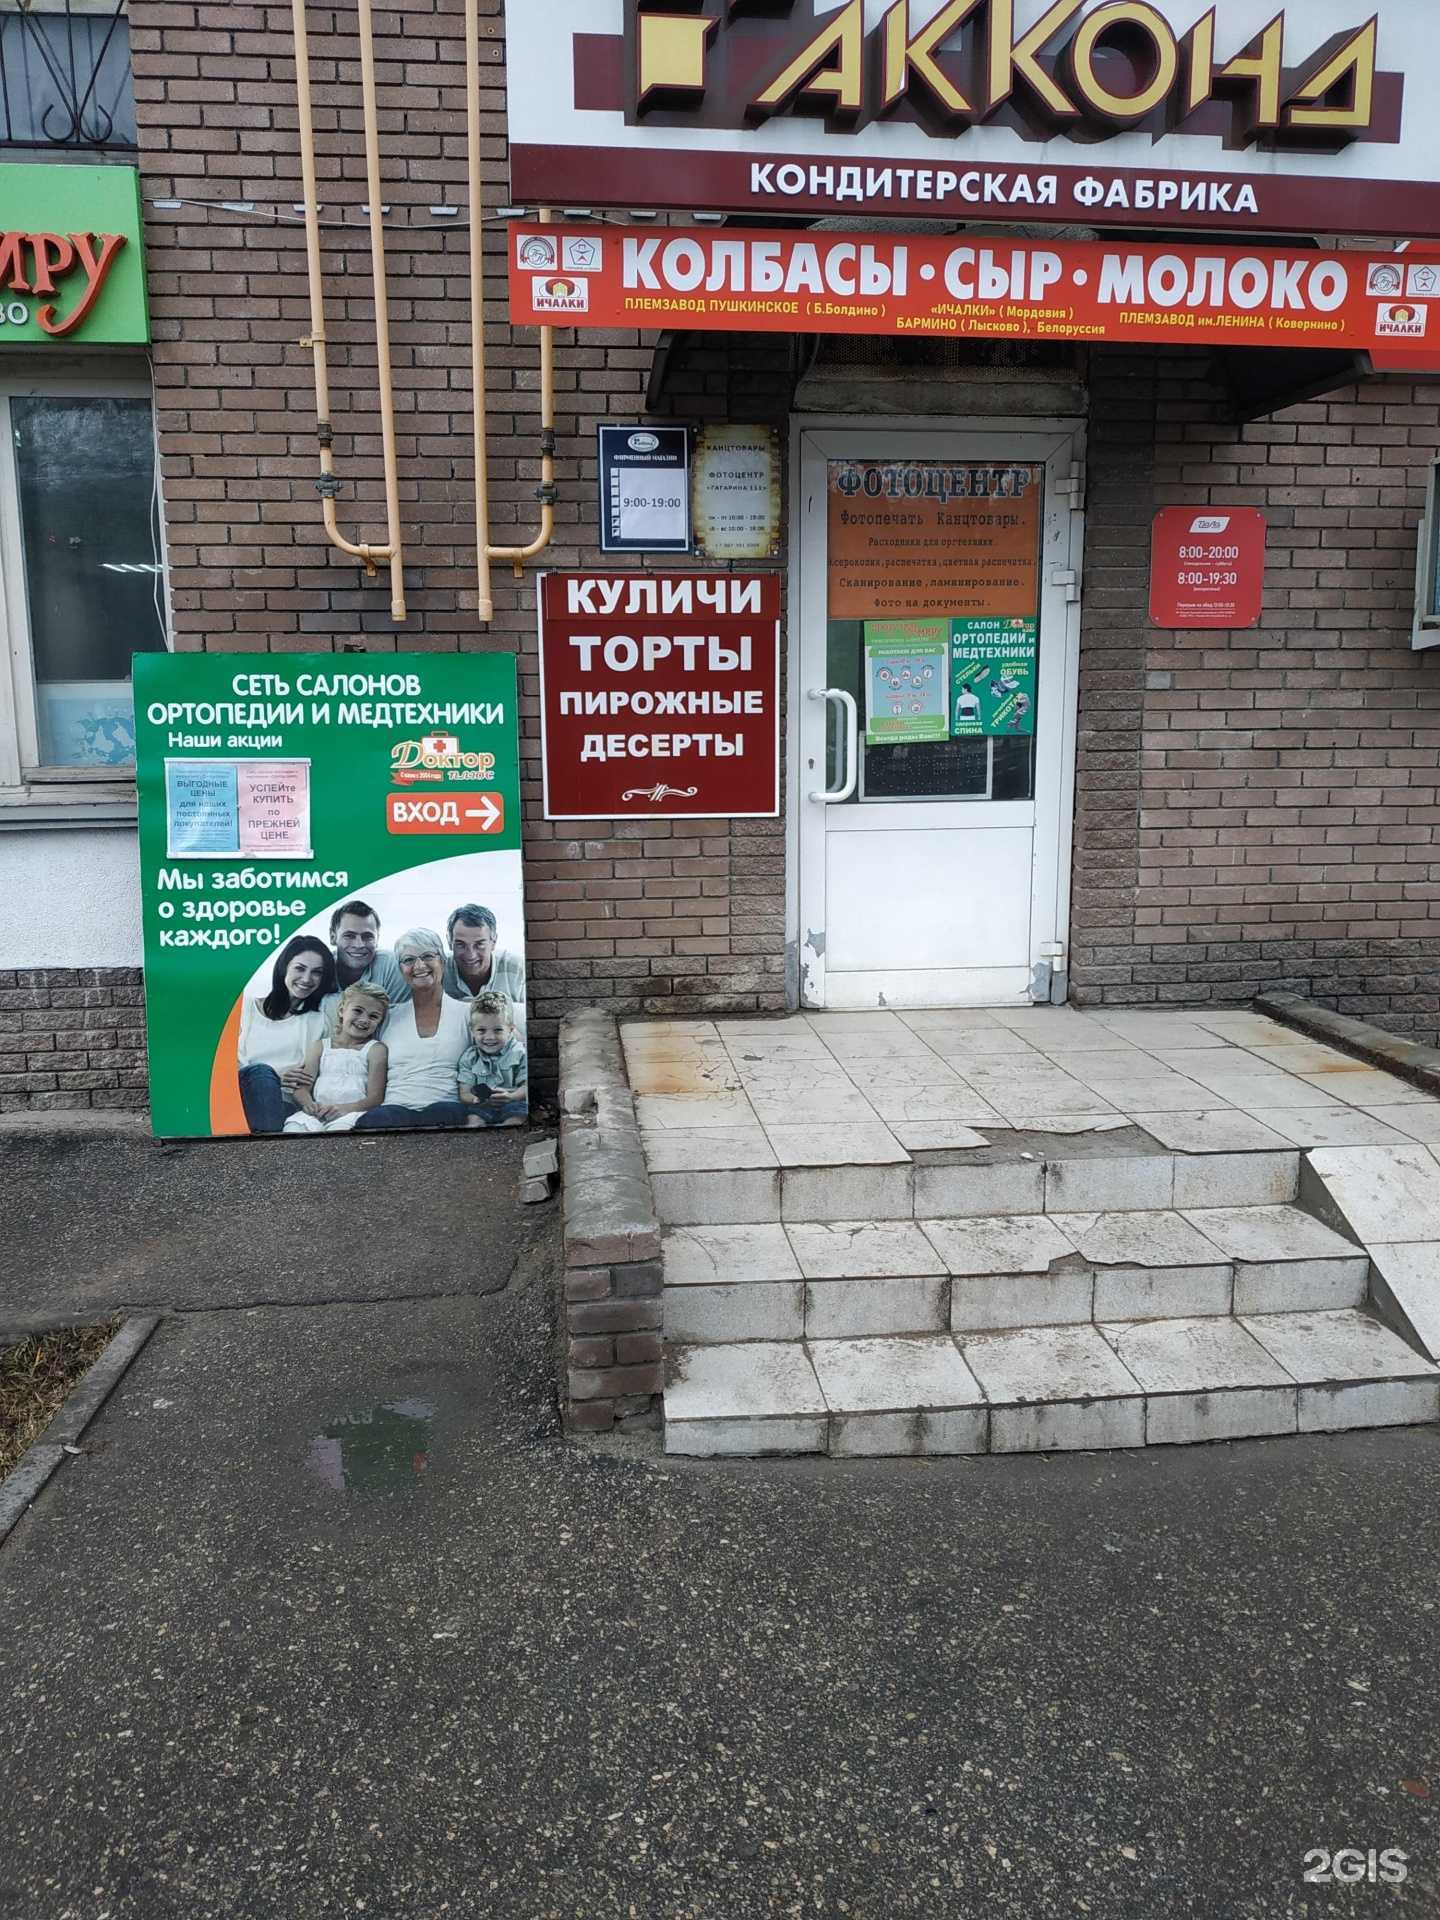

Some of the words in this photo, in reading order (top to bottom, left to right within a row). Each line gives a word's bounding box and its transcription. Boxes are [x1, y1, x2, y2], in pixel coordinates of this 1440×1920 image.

[752, 0, 1378, 129] АККОНД
[750, 162, 1057, 206] КОНДИТЕРСКАЯ
[1073, 175, 1259, 214] ФАБРИКА
[622, 237, 908, 297] КОЛБАСЫ
[943, 246, 1063, 302] СЫР
[1096, 253, 1348, 313] МОЛОКО
[624, 297, 706, 313] ПЛЕМЗАВОД
[709, 299, 799, 314] ПУШКИНСКОЕ
[896, 316, 957, 330] БАРМИНО
[1037, 321, 1105, 336] Белоруссия
[1119, 311, 1195, 327] ПЛЕМЗАВОД
[708, 471, 765, 480] ФОТОЦЕНТР
[838, 466, 1032, 504] ФОТОЦЕНТР
[623, 497, 681, 508] 9:00-19:00
[840, 509, 924, 526] Фотопечать
[937, 511, 1026, 529] Канцтовары.
[1178, 545, 1239, 558] 8:00-20:00
[1177, 571, 1237, 584] 8:00-19:30
[567, 579, 761, 614] КУЛИЧИ
[874, 598, 902, 608] Фото
[905, 599, 919, 608] на
[967, 621, 1000, 630] САЛОН
[953, 632, 1026, 646] ОРТОПЕДИИ
[569, 635, 752, 672] ТОРТЫ
[952, 646, 1035, 660] МЕДТЕХНИКИ
[1000, 668, 1029, 676] ОБУВЬ
[232, 674, 290, 696] СЕТЬ
[296, 674, 422, 696] САЛОНОВ
[560, 690, 764, 715] ПИРОЖНЫЕ
[147, 702, 304, 729] ОРТОПЕДИИ
[311, 703, 330, 724] И
[337, 702, 504, 728] МЕДТЕХНИКИ
[954, 727, 984, 735] СПИНА
[168, 732, 222, 748] Наши
[227, 734, 283, 750] акции
[580, 733, 744, 762] ДЕСЕРТЫ
[250, 782, 296, 792] УСПЕЙте
[253, 794, 294, 804] КУПИТЬ
[393, 801, 459, 826] ВХОД
[248, 817, 300, 829] ПРЕЖНЕЙ
[261, 831, 289, 840] ЦЕНЕ
[157, 869, 204, 889] Мы
[211, 869, 348, 889] заботимся
[158, 902, 175, 918] о
[182, 900, 306, 923] здоровье
[159, 923, 281, 951] каждого!
